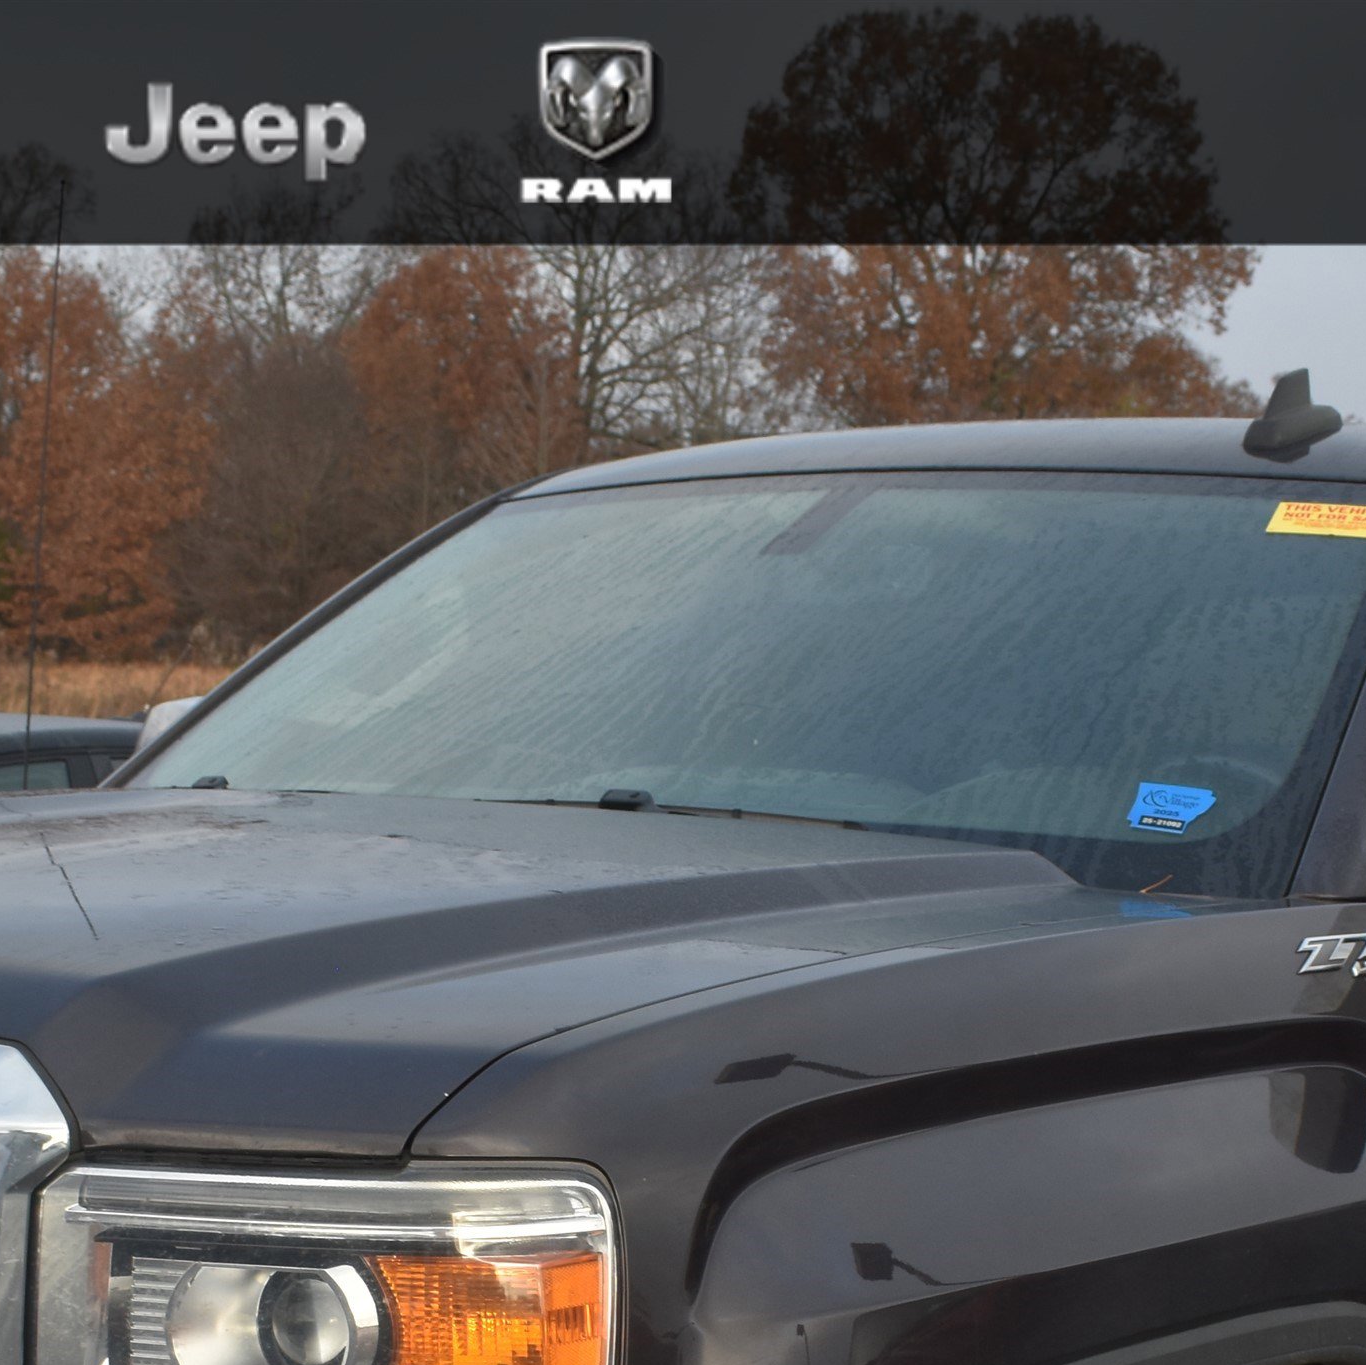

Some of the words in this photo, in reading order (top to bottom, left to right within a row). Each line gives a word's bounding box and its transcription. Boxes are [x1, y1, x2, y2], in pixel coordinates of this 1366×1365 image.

[1286, 503, 1323, 513] THIS
[1283, 511, 1311, 520] NOT
[1317, 513, 1348, 521] FOR
